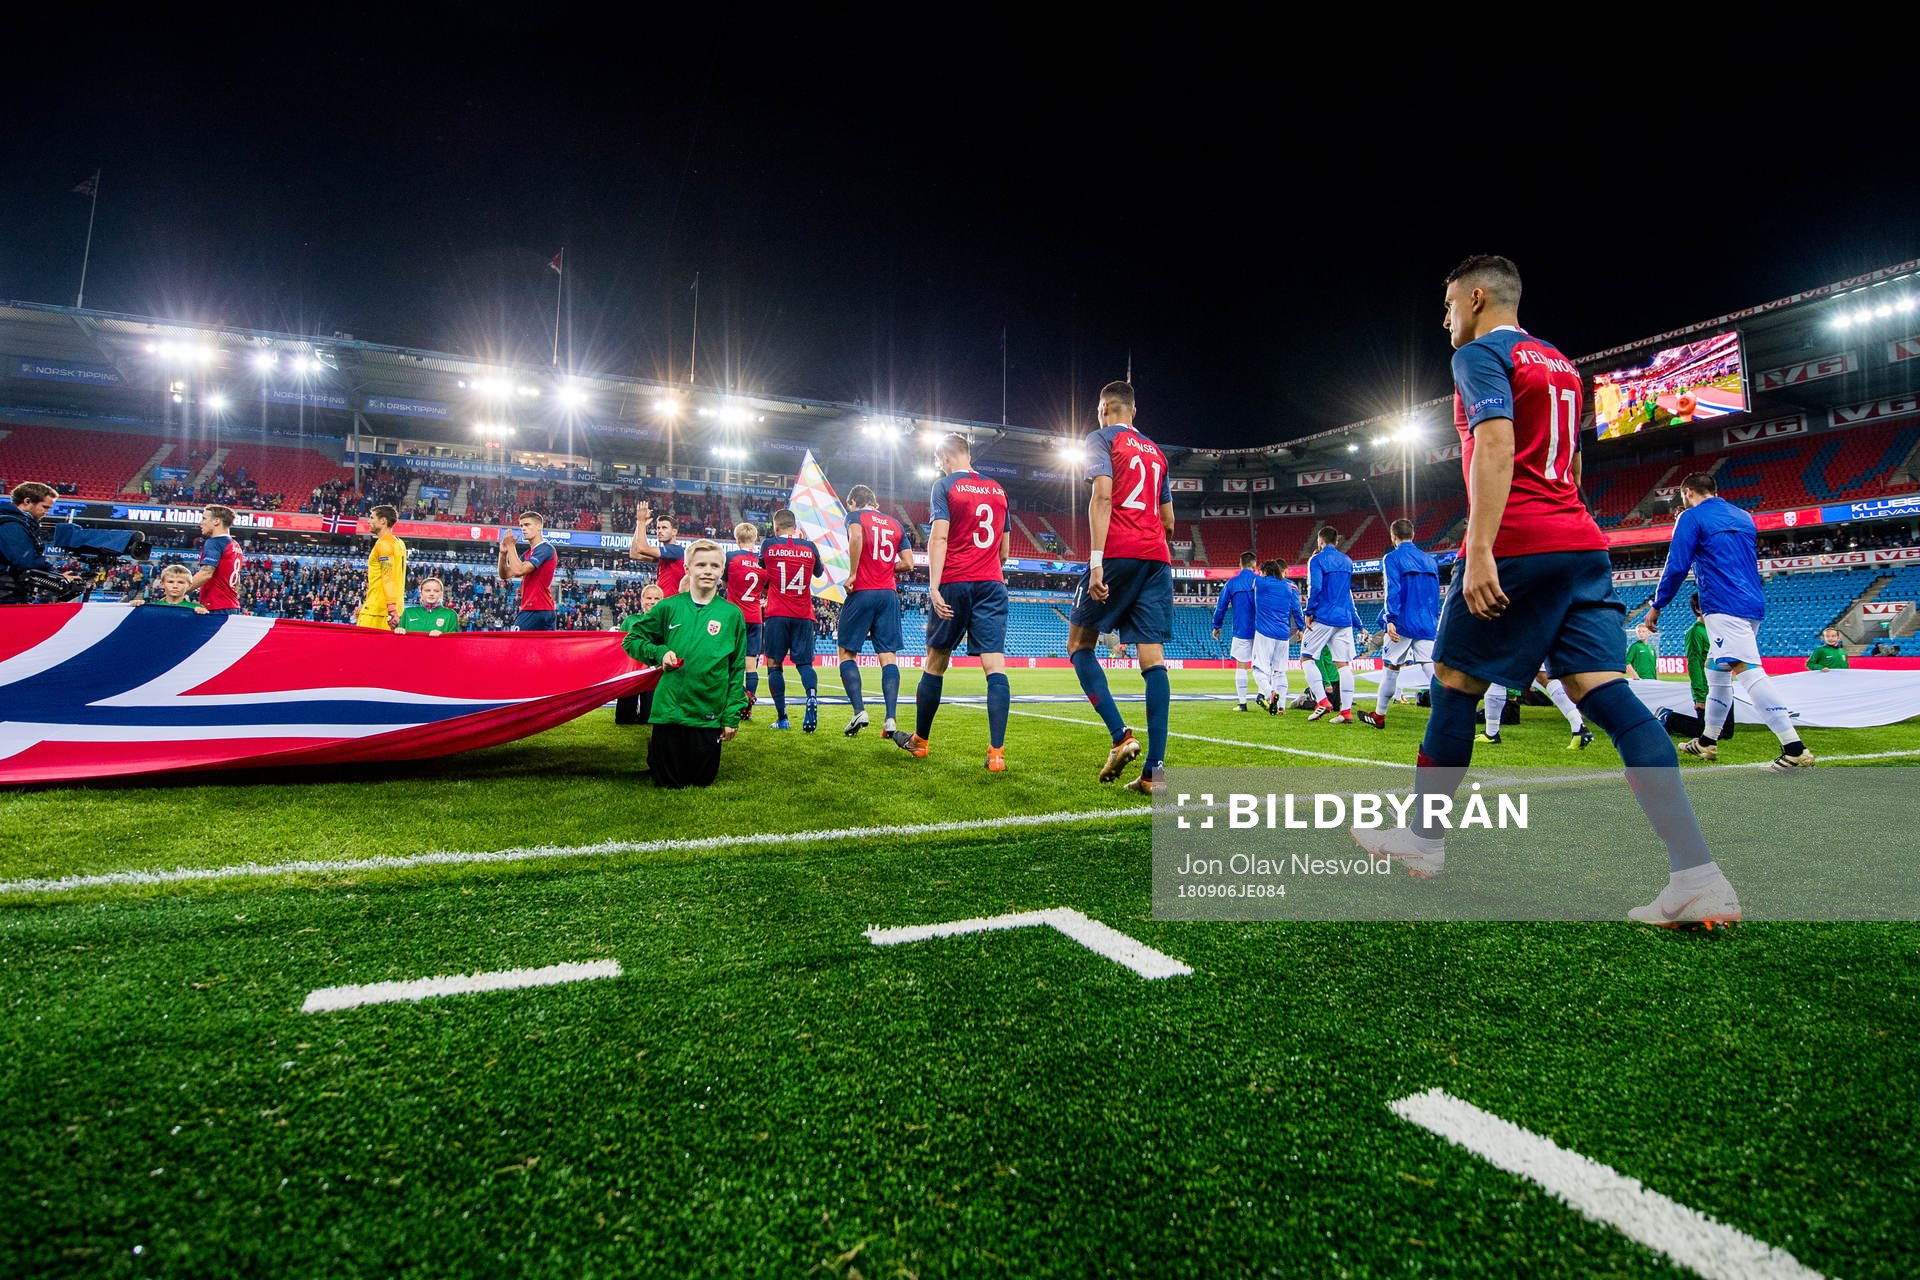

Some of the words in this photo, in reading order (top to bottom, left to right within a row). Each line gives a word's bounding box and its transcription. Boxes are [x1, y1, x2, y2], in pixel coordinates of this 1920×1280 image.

[1762, 297, 1792, 311] VG
[36, 366, 75, 377] NORSK
[78, 370, 119, 381] TIPPING
[1764, 355, 1848, 389] VG
[273, 391, 307, 401] NORSK
[308, 394, 345, 404] TIPPING
[1474, 398, 1504, 410] RESPECT
[379, 402, 412, 411] NORSK
[413, 405, 447, 415] TIPPING
[1728, 413, 1802, 444] VG
[1303, 470, 1346, 485] VG
[956, 484, 991, 495] VASSBAKK
[1121, 455, 1161, 516] 21
[1228, 479, 1271, 492] VG
[1204, 506, 1248, 517] VG
[1267, 503, 1312, 516] VG
[1852, 507, 1920, 520] ULLEVAAL
[127, 508, 274, 528] www.klubbaal.no
[972, 503, 995, 549] 3
[872, 526, 895, 562] 15
[768, 549, 813, 559] ELABDELLAOUI
[1821, 553, 1866, 565] VG
[1875, 548, 1920, 560] VG
[1771, 559, 1813, 568] VG
[229, 557, 241, 587] 8
[777, 561, 806, 595] 14
[1176, 569, 1206, 578] ULLEVAAL
[741, 572, 759, 602] 2
[857, 656, 880, 667] LEAGU
[1110, 659, 1132, 669] LEAGUE
